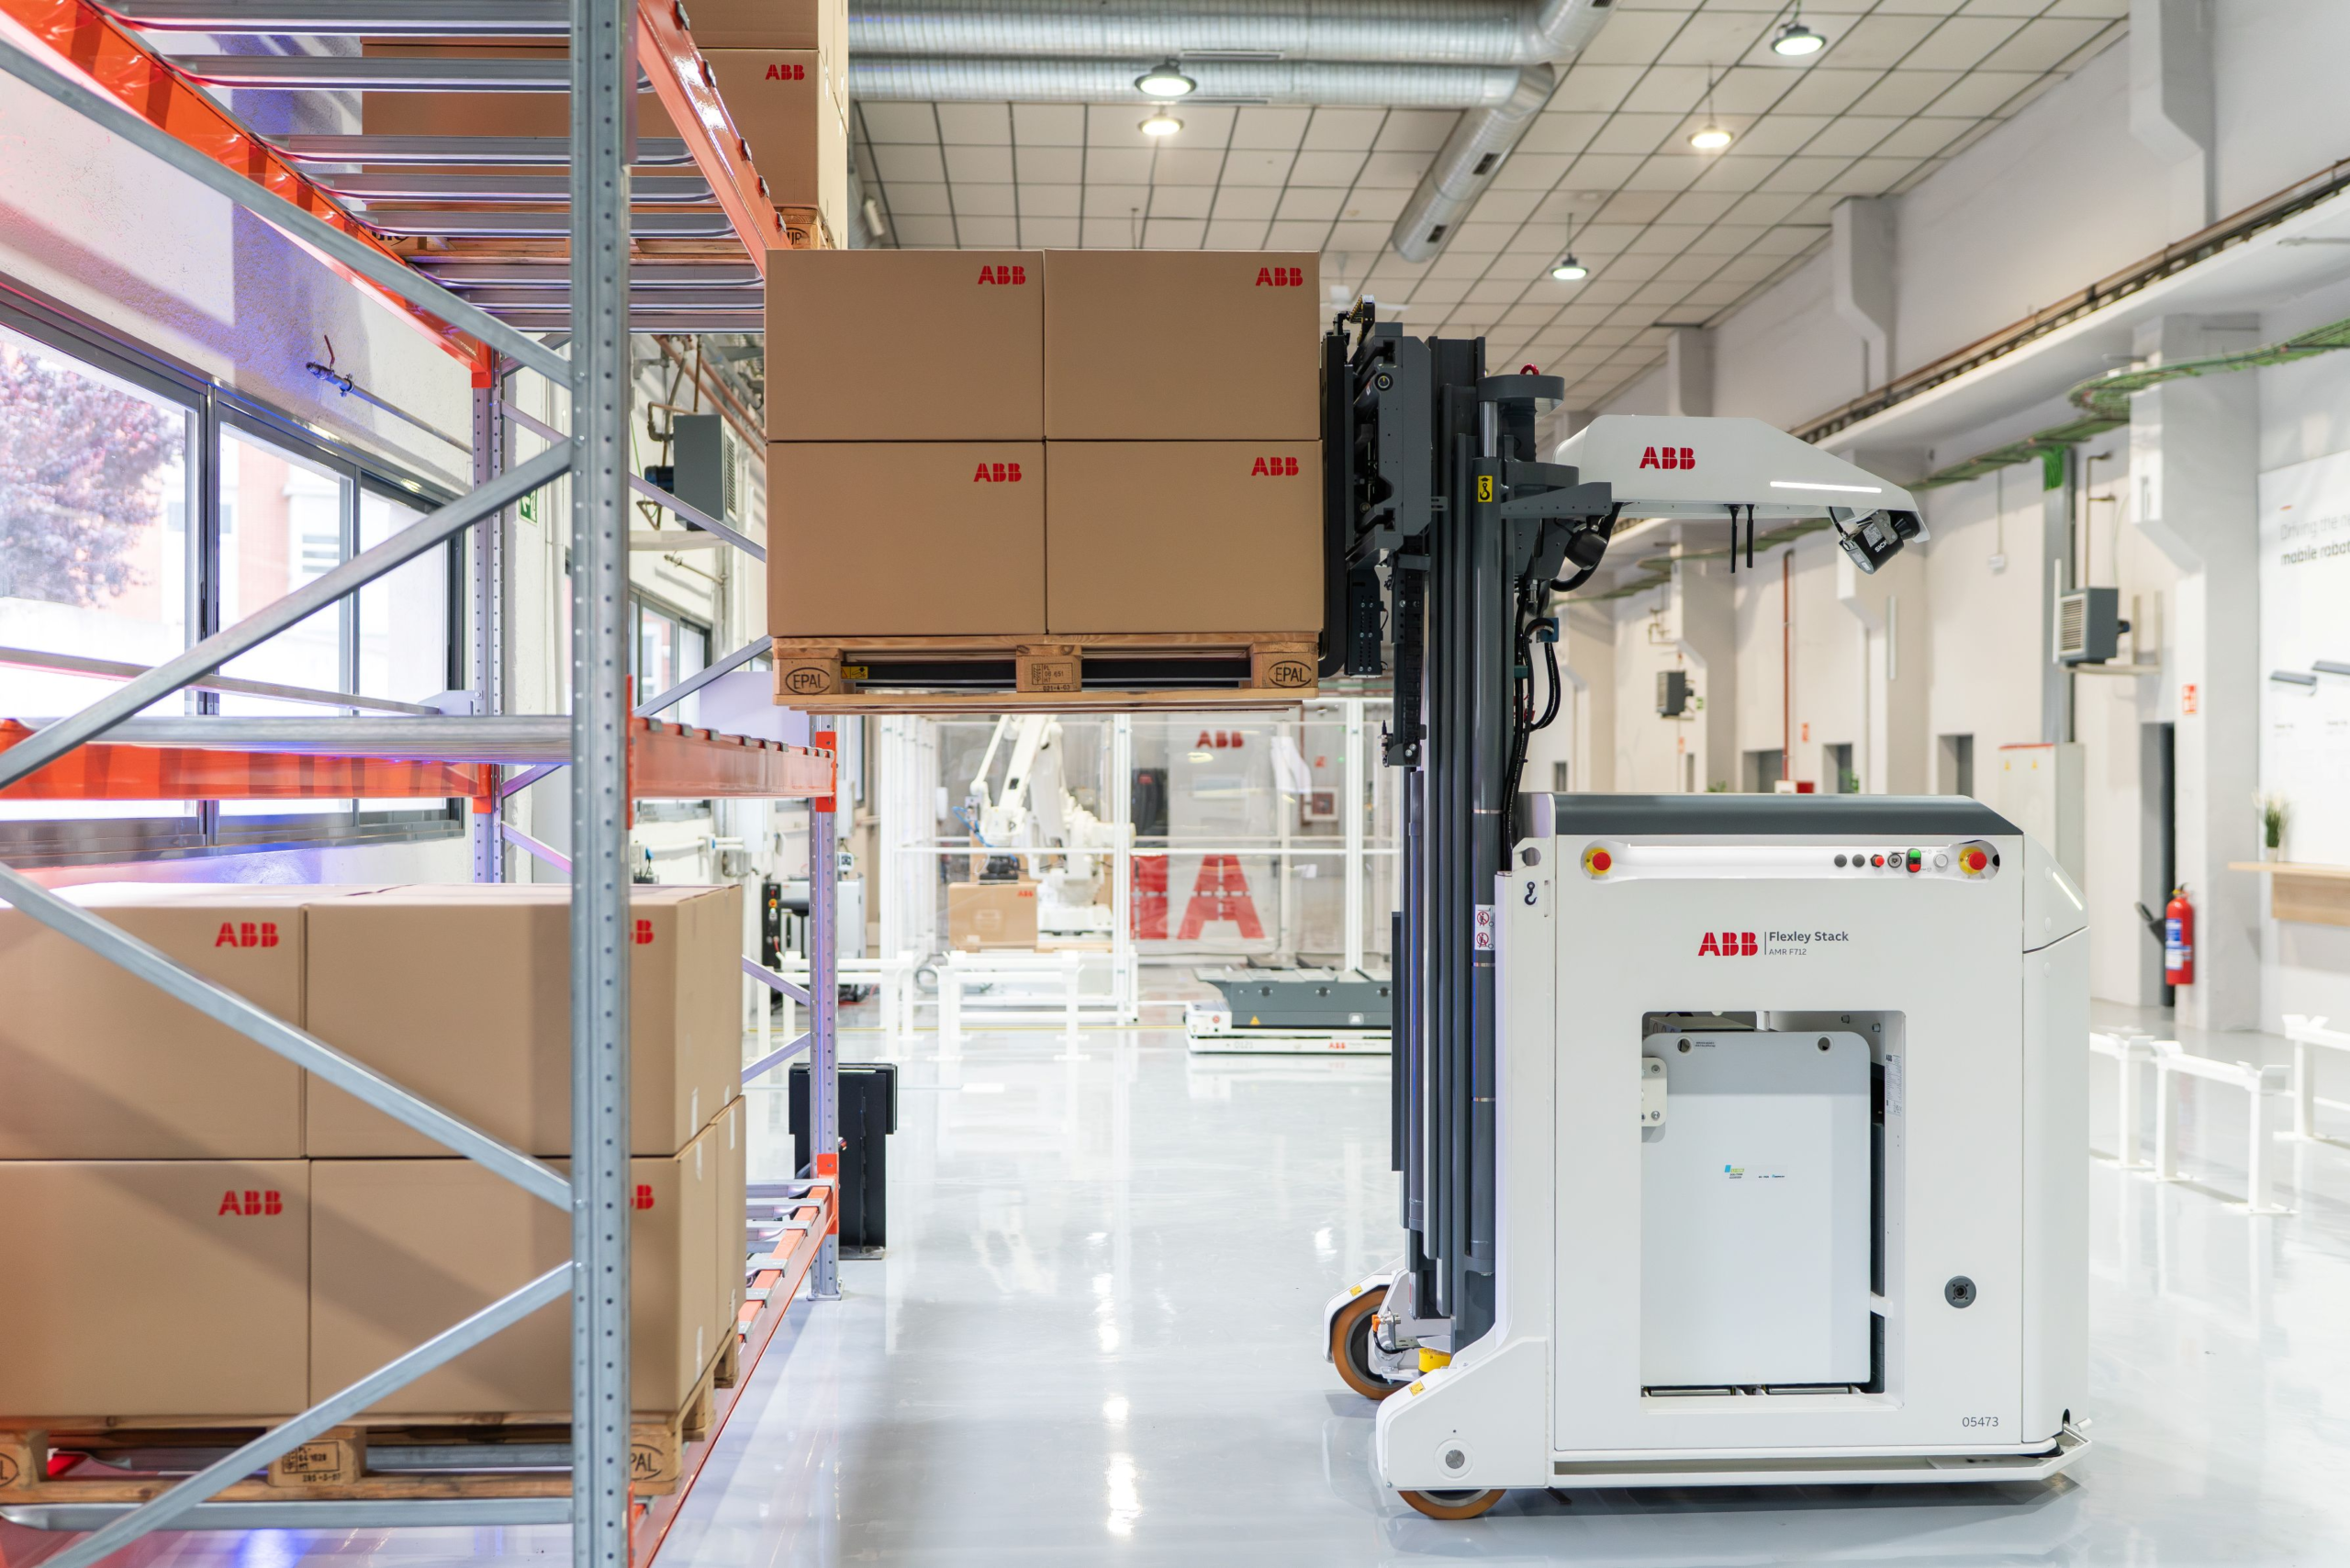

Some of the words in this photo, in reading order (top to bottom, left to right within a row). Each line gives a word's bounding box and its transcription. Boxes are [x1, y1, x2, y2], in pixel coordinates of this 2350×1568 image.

[766, 63, 805, 81] ABB
[978, 265, 1026, 285] ABB
[1255, 266, 1304, 287] ABB
[1251, 456, 1300, 476] ABB
[1639, 446, 1695, 469] ABB
[973, 463, 1022, 483] ABB
[2281, 544, 2317, 566] mobile
[792, 673, 825, 689] EPAL
[1275, 666, 1307, 682] EPAL
[1196, 731, 1245, 748] ABB
[215, 922, 279, 947] ABB
[1697, 932, 1759, 957] ABB
[1769, 931, 1811, 944] Flexley
[1814, 931, 1849, 942] Stack
[218, 1190, 283, 1216] ABB
[1962, 1417, 1999, 1428] 05473
